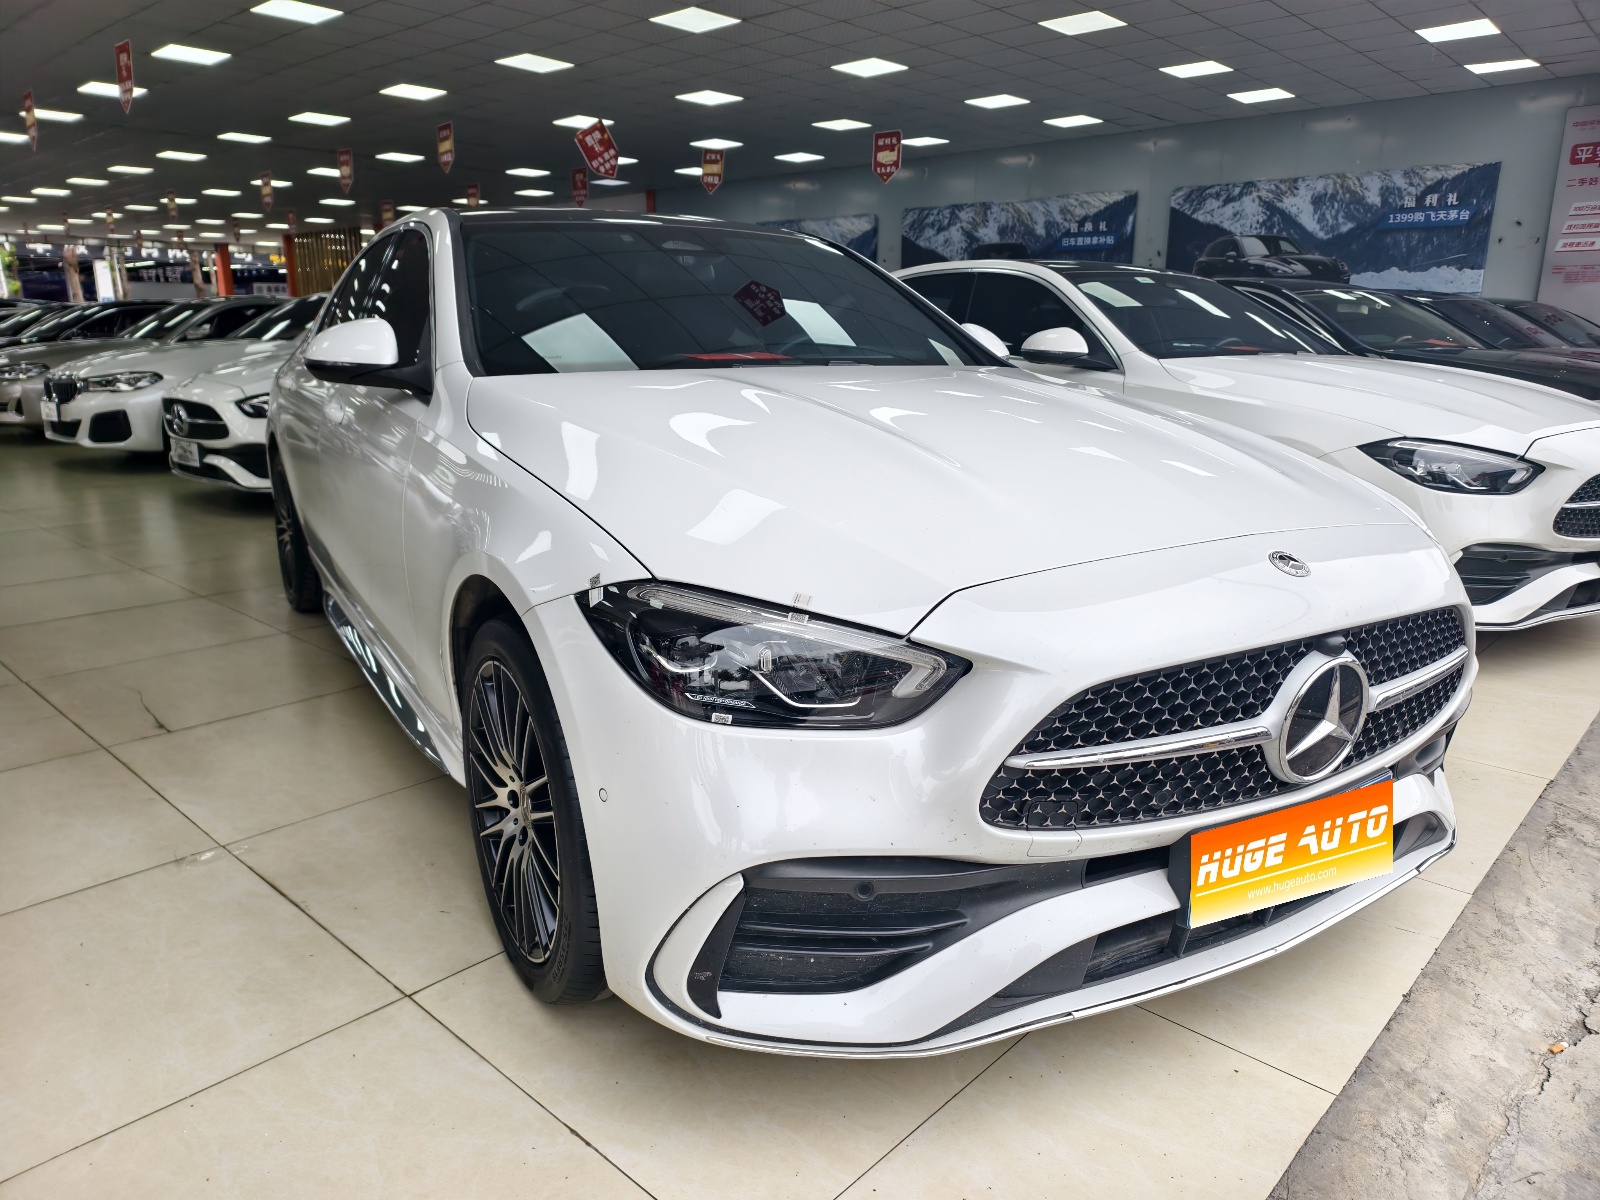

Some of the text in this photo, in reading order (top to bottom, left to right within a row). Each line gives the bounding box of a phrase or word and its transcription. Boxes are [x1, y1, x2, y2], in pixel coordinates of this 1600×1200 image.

[1403, 193, 1460, 208] 福利礼
[1388, 209, 1470, 223] 1399购飞天茅台
